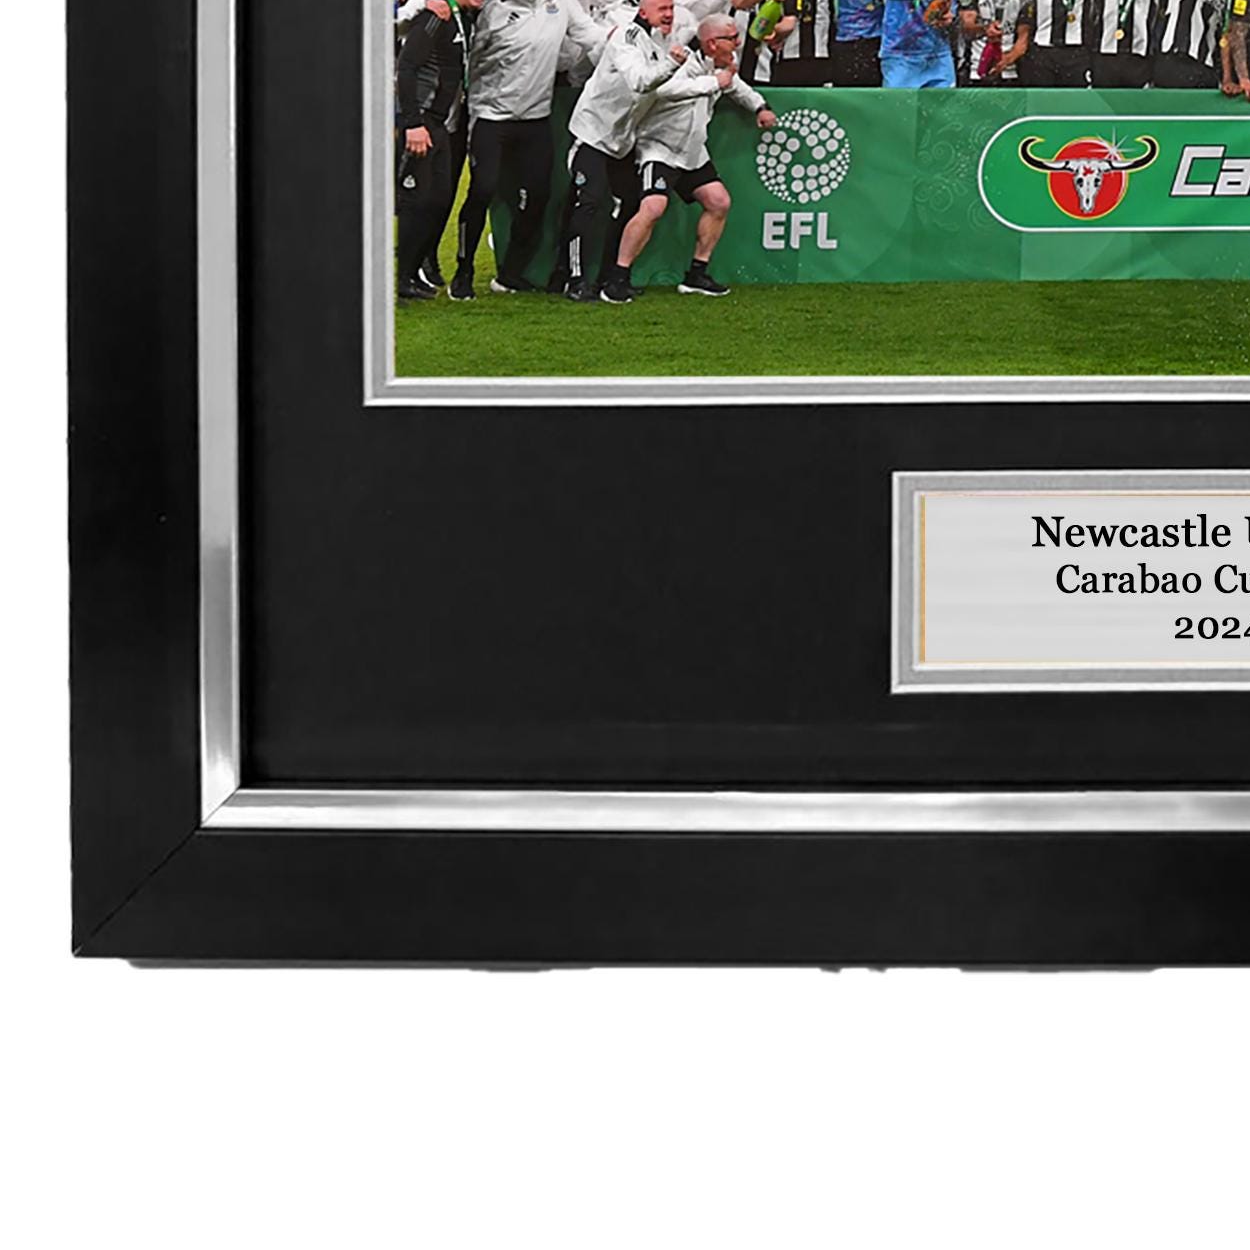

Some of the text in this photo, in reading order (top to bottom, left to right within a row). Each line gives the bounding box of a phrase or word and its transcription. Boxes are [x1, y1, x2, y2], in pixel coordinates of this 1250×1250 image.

[762, 212, 838, 250] EFL
[1031, 513, 1232, 548] Newcastle
[1056, 562, 1202, 594] Carabao
